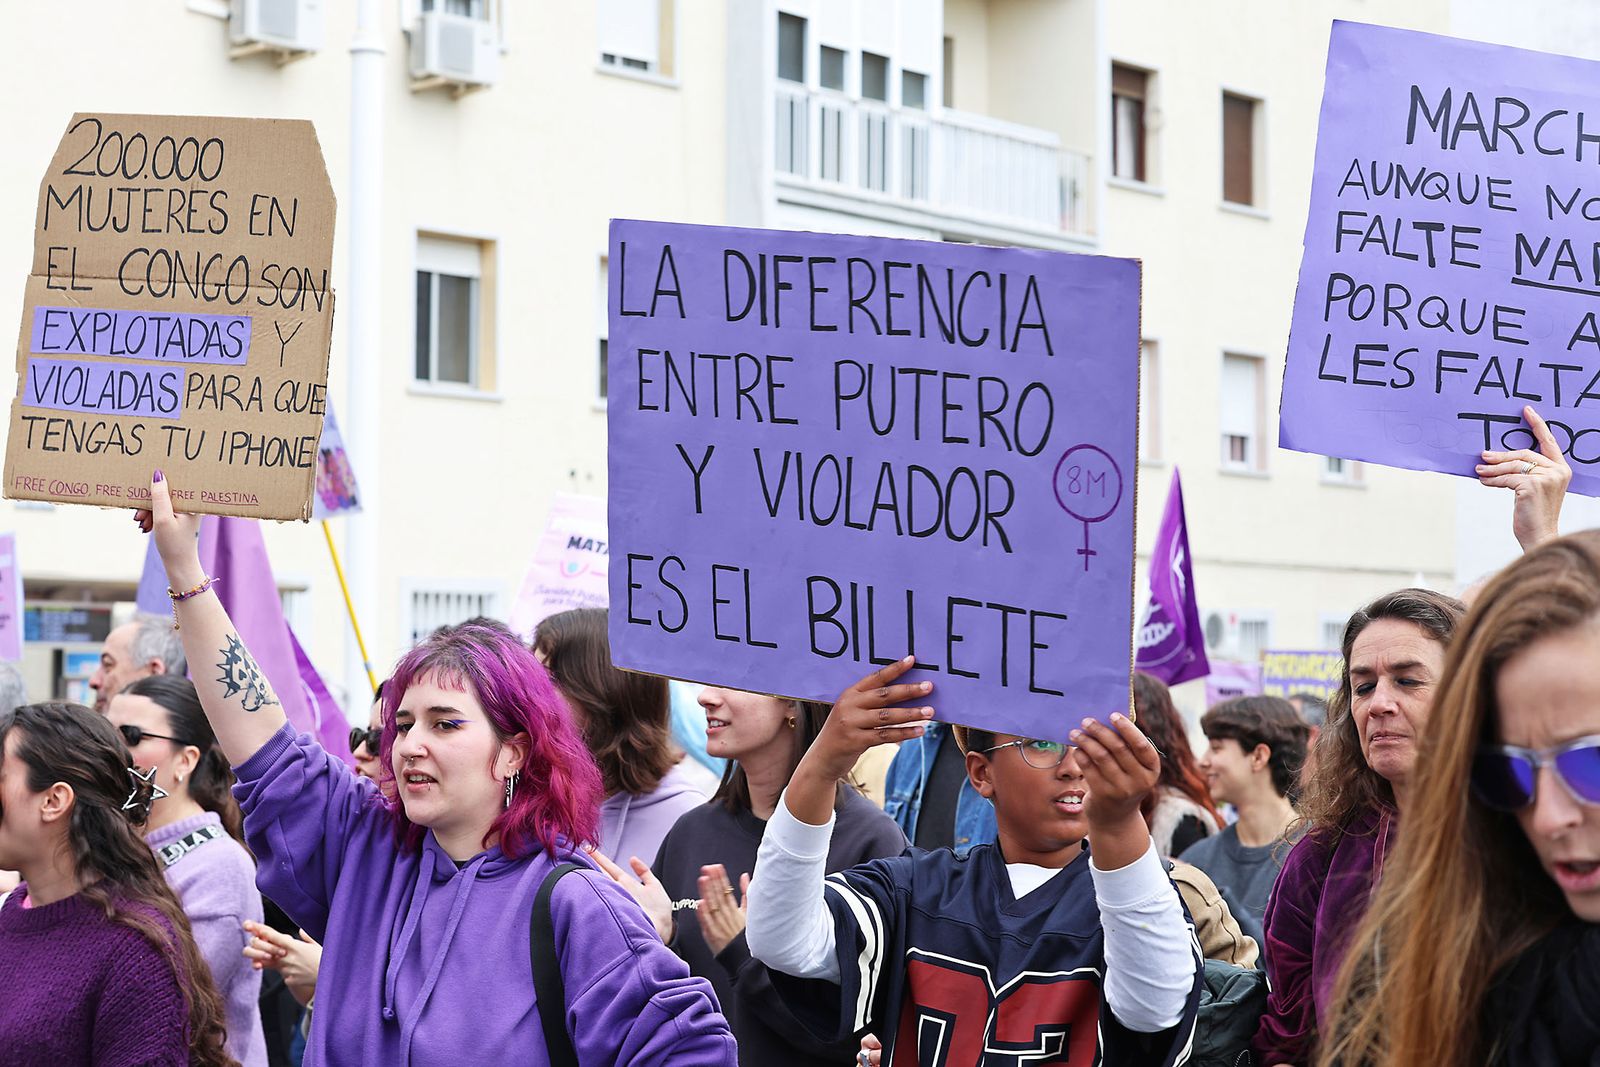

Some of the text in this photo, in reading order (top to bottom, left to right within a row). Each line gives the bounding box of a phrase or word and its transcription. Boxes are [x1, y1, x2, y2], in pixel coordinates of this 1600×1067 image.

[63, 119, 223, 181] 200.000
[44, 185, 297, 237] MUJERES EN
[1338, 159, 1516, 213] AUNQUE
[1336, 211, 1600, 286] FALTE NA
[47, 247, 327, 312] EL CONGO SON
[621, 242, 1054, 356] LA DIFERENCIA
[42, 311, 302, 367] EXPLOTADAS Y
[1325, 273, 1529, 346] PORQUE
[33, 365, 326, 416] VIOLADAS PARA QUE
[1319, 334, 1418, 388] LES
[638, 349, 1054, 457] ENTRE PUTERO
[22, 416, 315, 468] TENGAS TU IPHONE
[15, 476, 46, 493] FREE
[96, 484, 122, 498] FREE
[201, 490, 259, 504] PALESTINA
[676, 444, 1014, 554] Y VIOLADOR
[1067, 465, 1106, 498] 8M
[628, 554, 1067, 697] ES EL BILLETE
